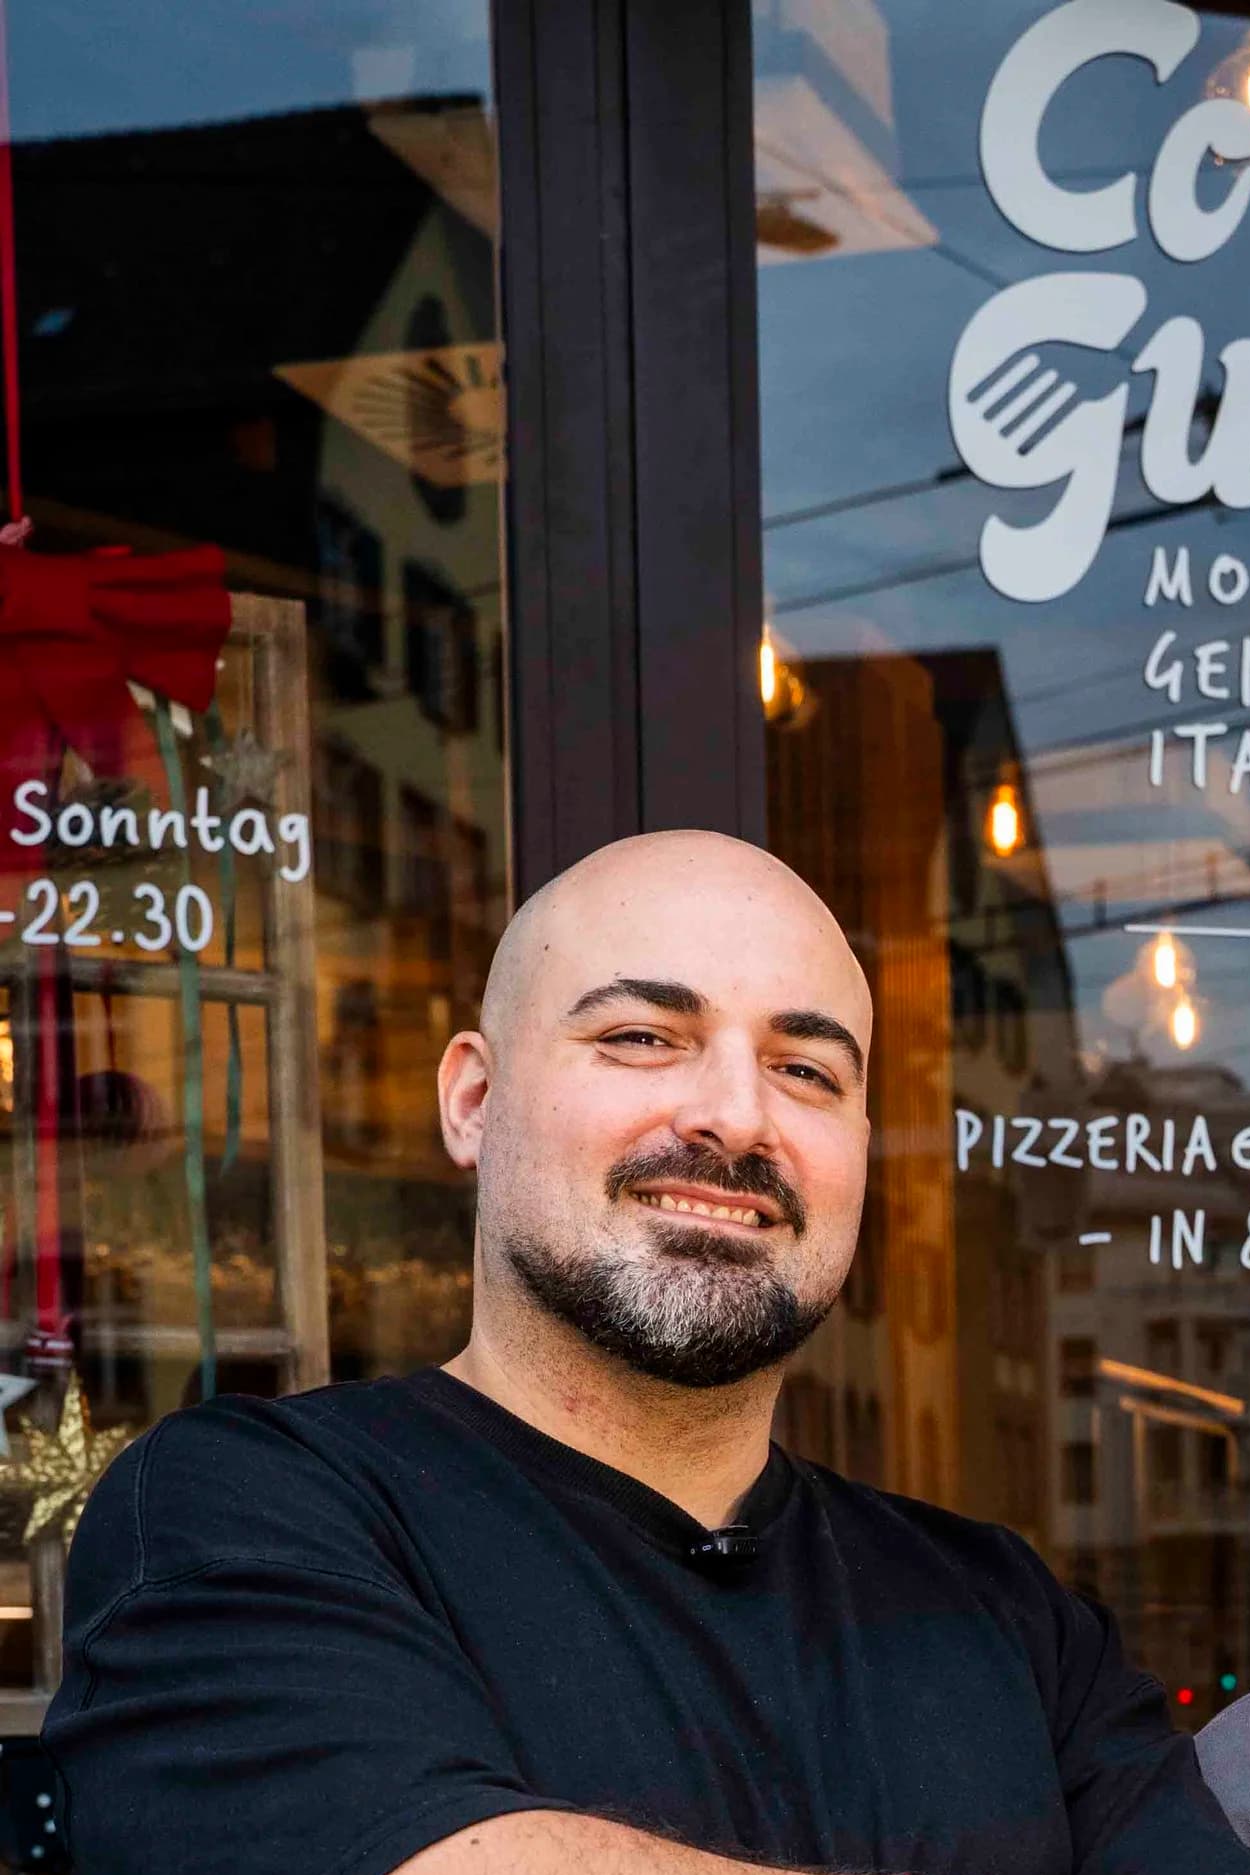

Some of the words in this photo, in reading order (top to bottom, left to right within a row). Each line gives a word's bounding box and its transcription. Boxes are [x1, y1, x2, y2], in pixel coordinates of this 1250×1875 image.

[10, 779, 312, 883] Sonntag
[955, 1108, 1218, 1176] PIZZERIA
[1148, 1208, 1206, 1270] IN
